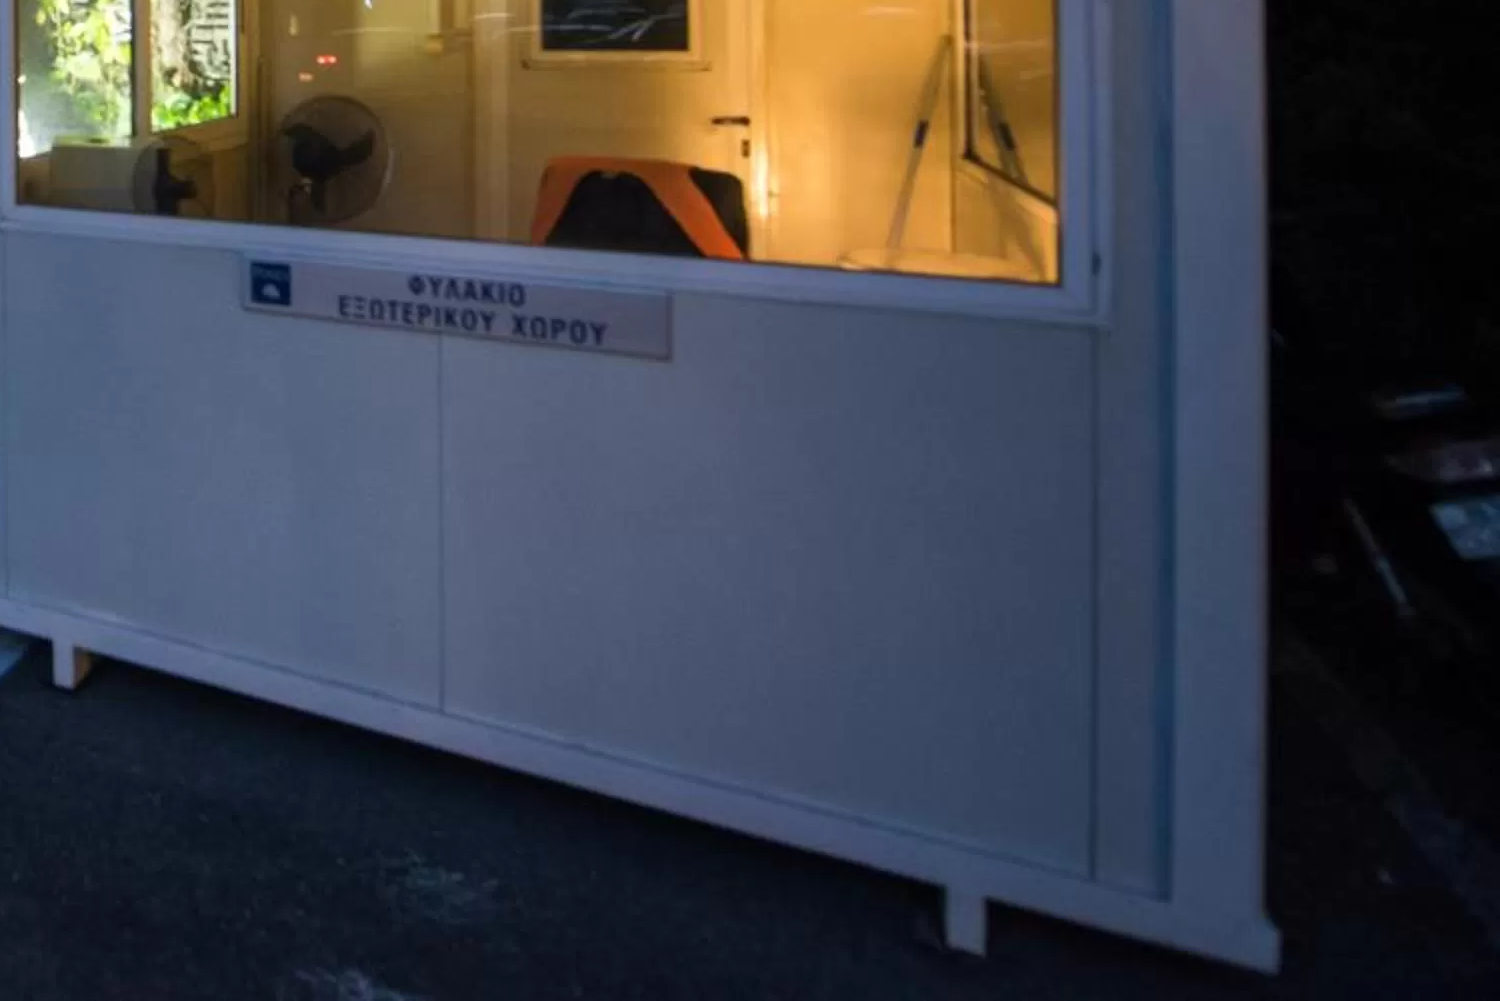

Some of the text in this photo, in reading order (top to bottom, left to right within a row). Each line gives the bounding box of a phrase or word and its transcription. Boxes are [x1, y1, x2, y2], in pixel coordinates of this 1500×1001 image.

[408, 274, 526, 308] ΦΥΛΑΚΙΟ
[338, 294, 608, 346] ΕΞΩΤΕΡΙΚΟΥ ΧΩΡΟΥ
